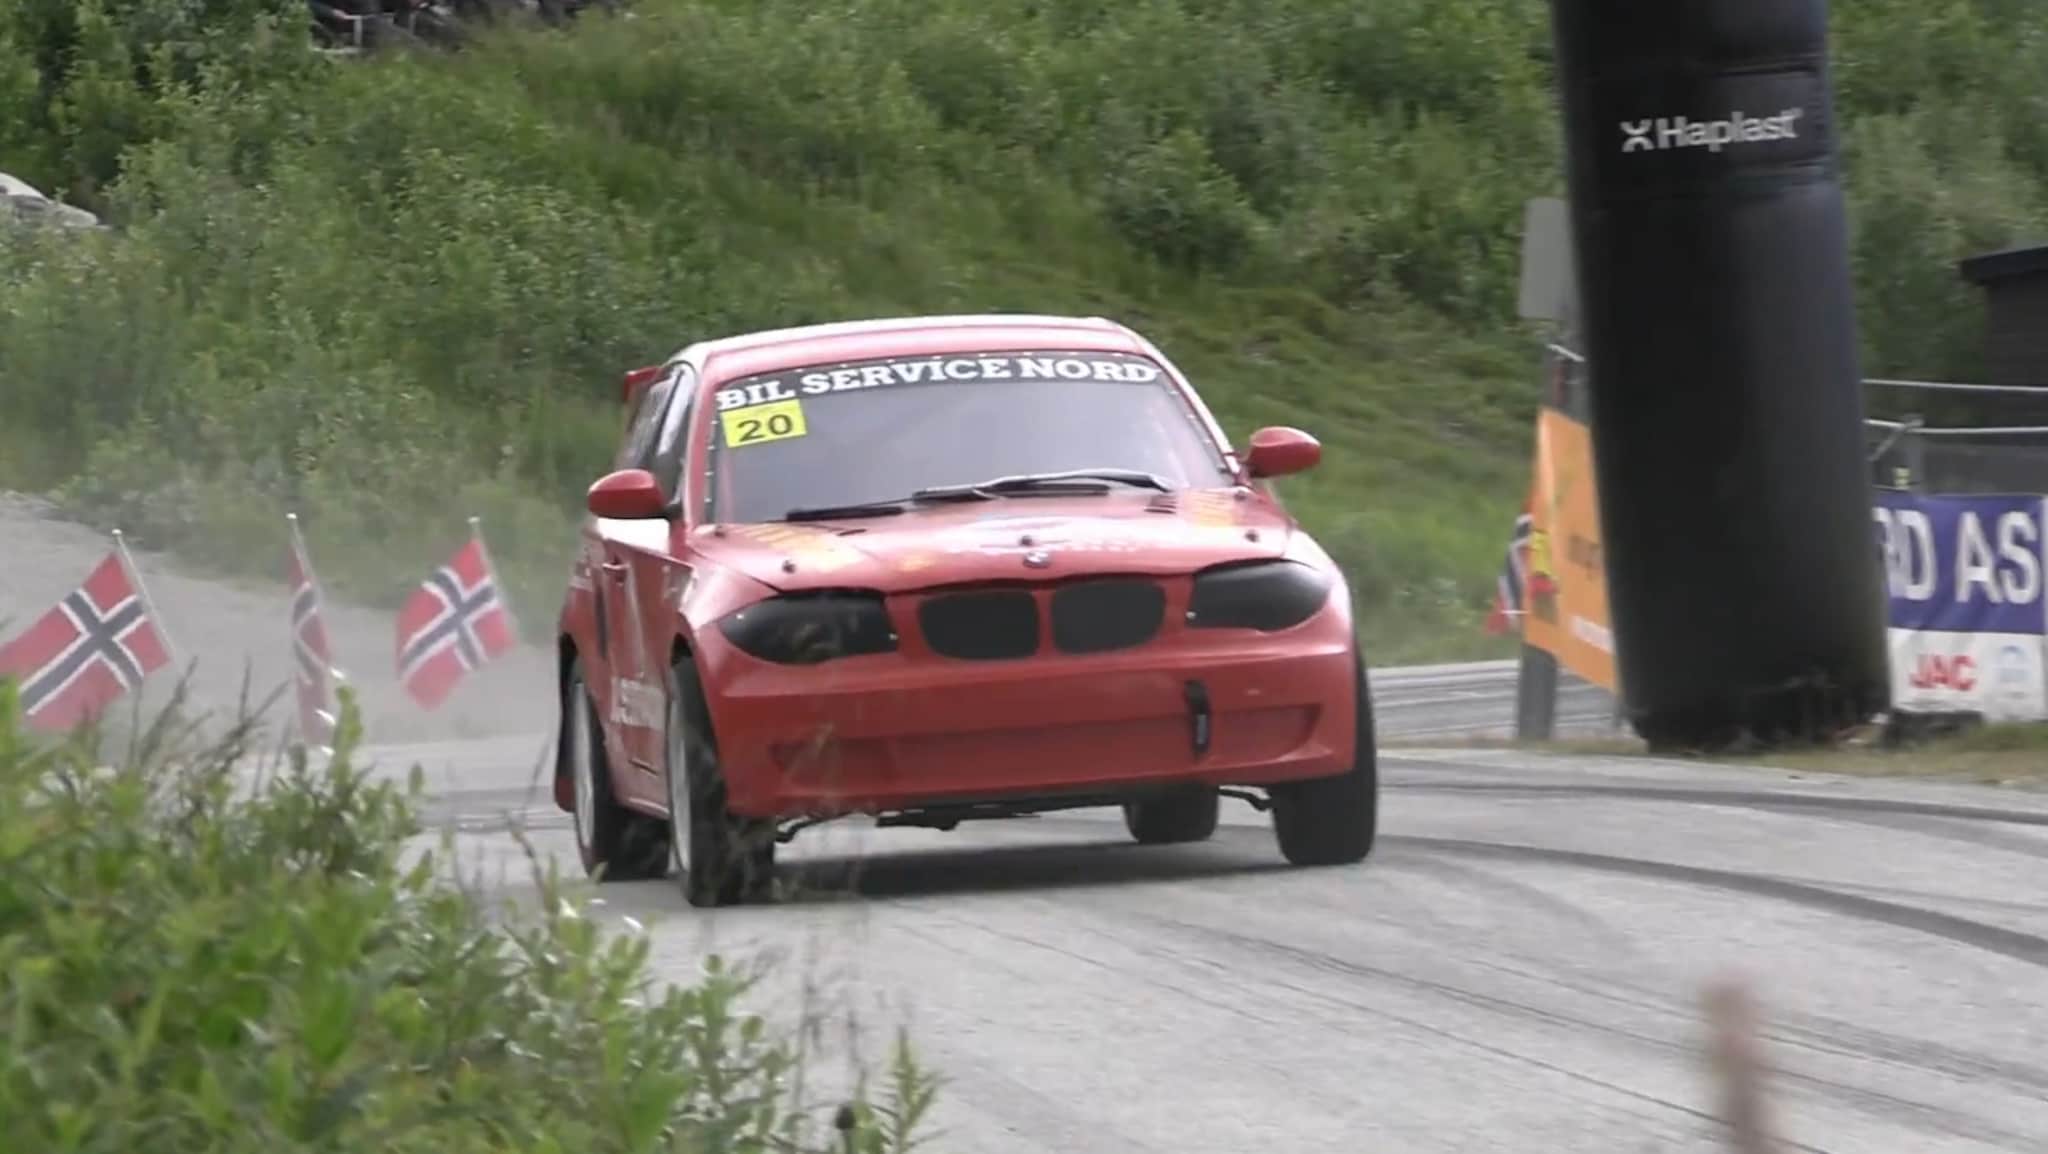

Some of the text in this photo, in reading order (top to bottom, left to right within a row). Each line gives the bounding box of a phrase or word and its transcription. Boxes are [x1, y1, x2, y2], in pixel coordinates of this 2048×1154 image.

[1656, 109, 1801, 153] Haplast
[716, 357, 1160, 411] BIL SERVICE NORD
[737, 413, 793, 442] 20
[1955, 511, 2040, 605] AS
